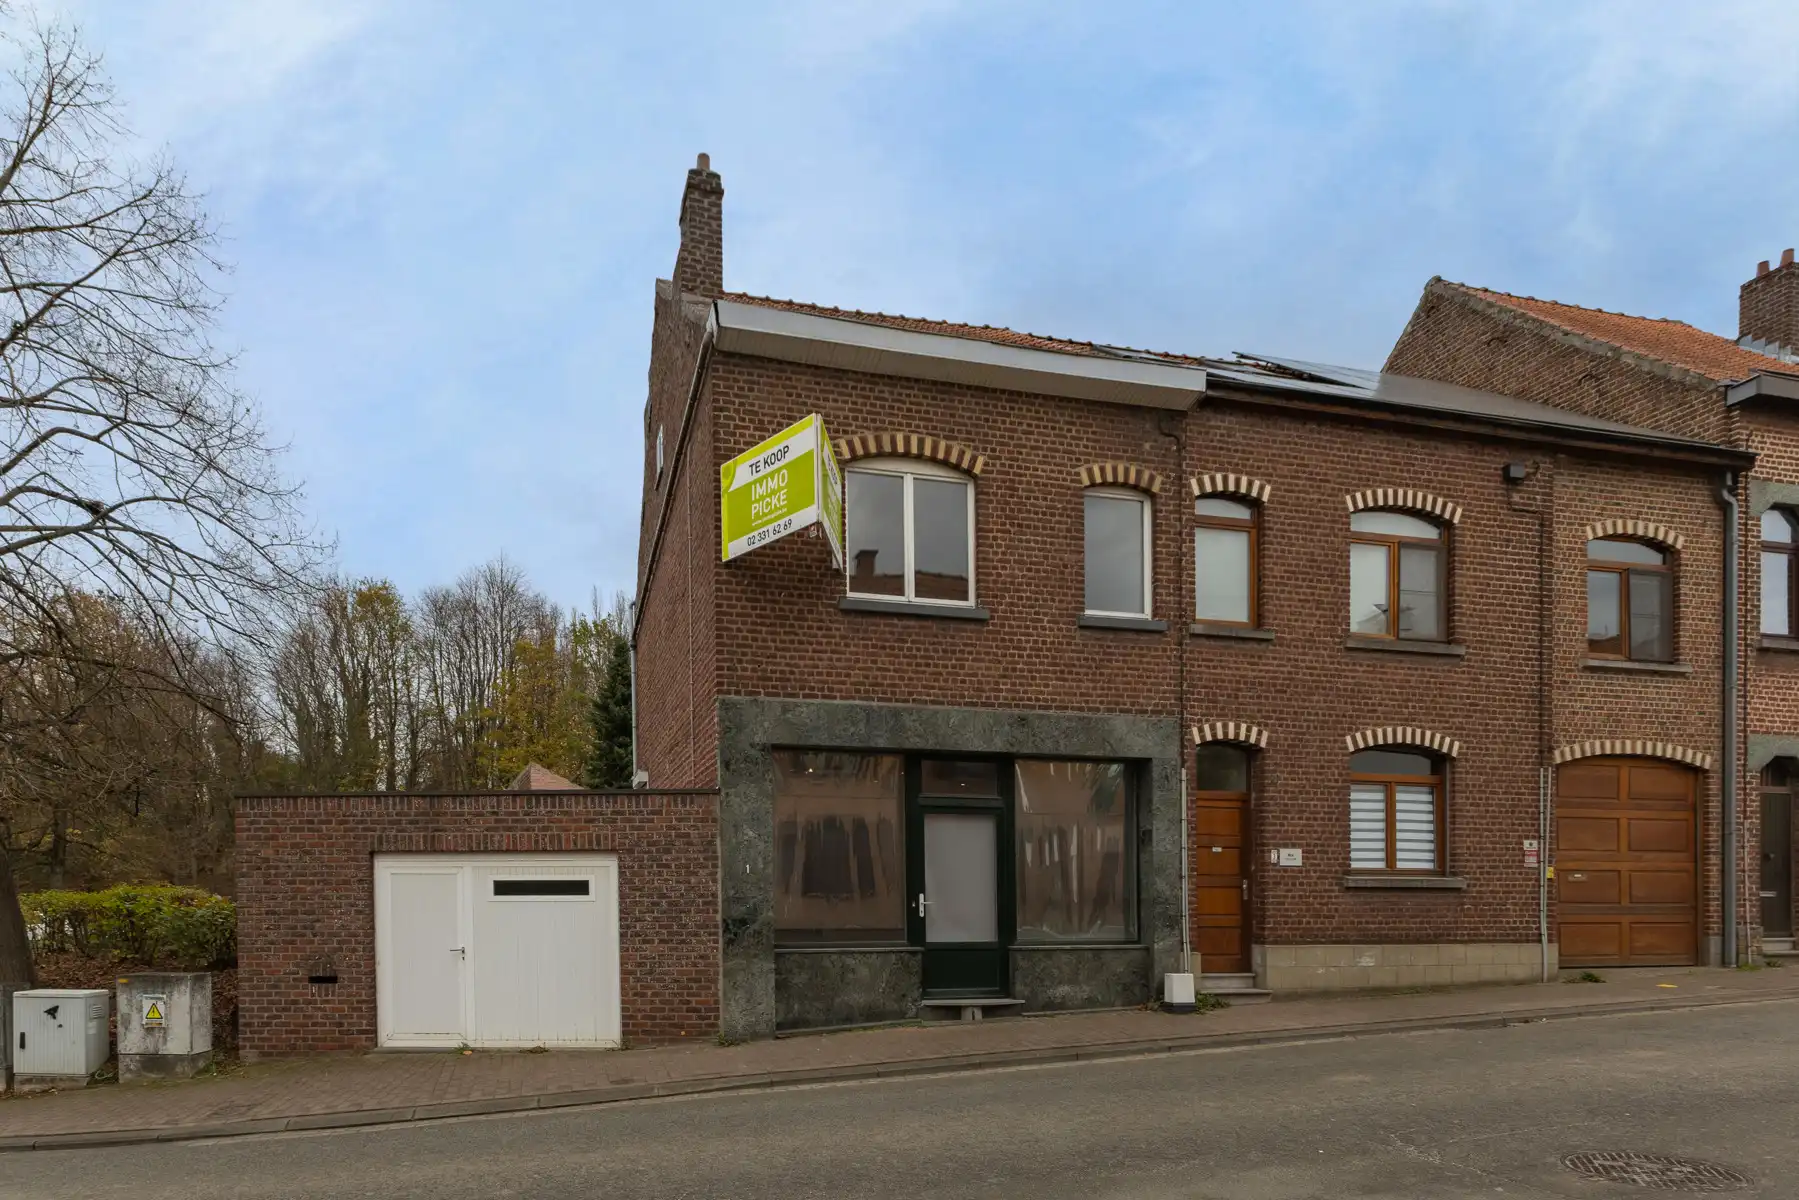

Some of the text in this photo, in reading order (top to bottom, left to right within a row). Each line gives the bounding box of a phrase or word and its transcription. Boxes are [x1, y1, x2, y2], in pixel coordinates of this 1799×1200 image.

[749, 445, 790, 476] TE KOOP
[751, 469, 788, 501] IMMO
[751, 489, 788, 519] PICKE
[747, 518, 793, 546] 02 331 62 69
